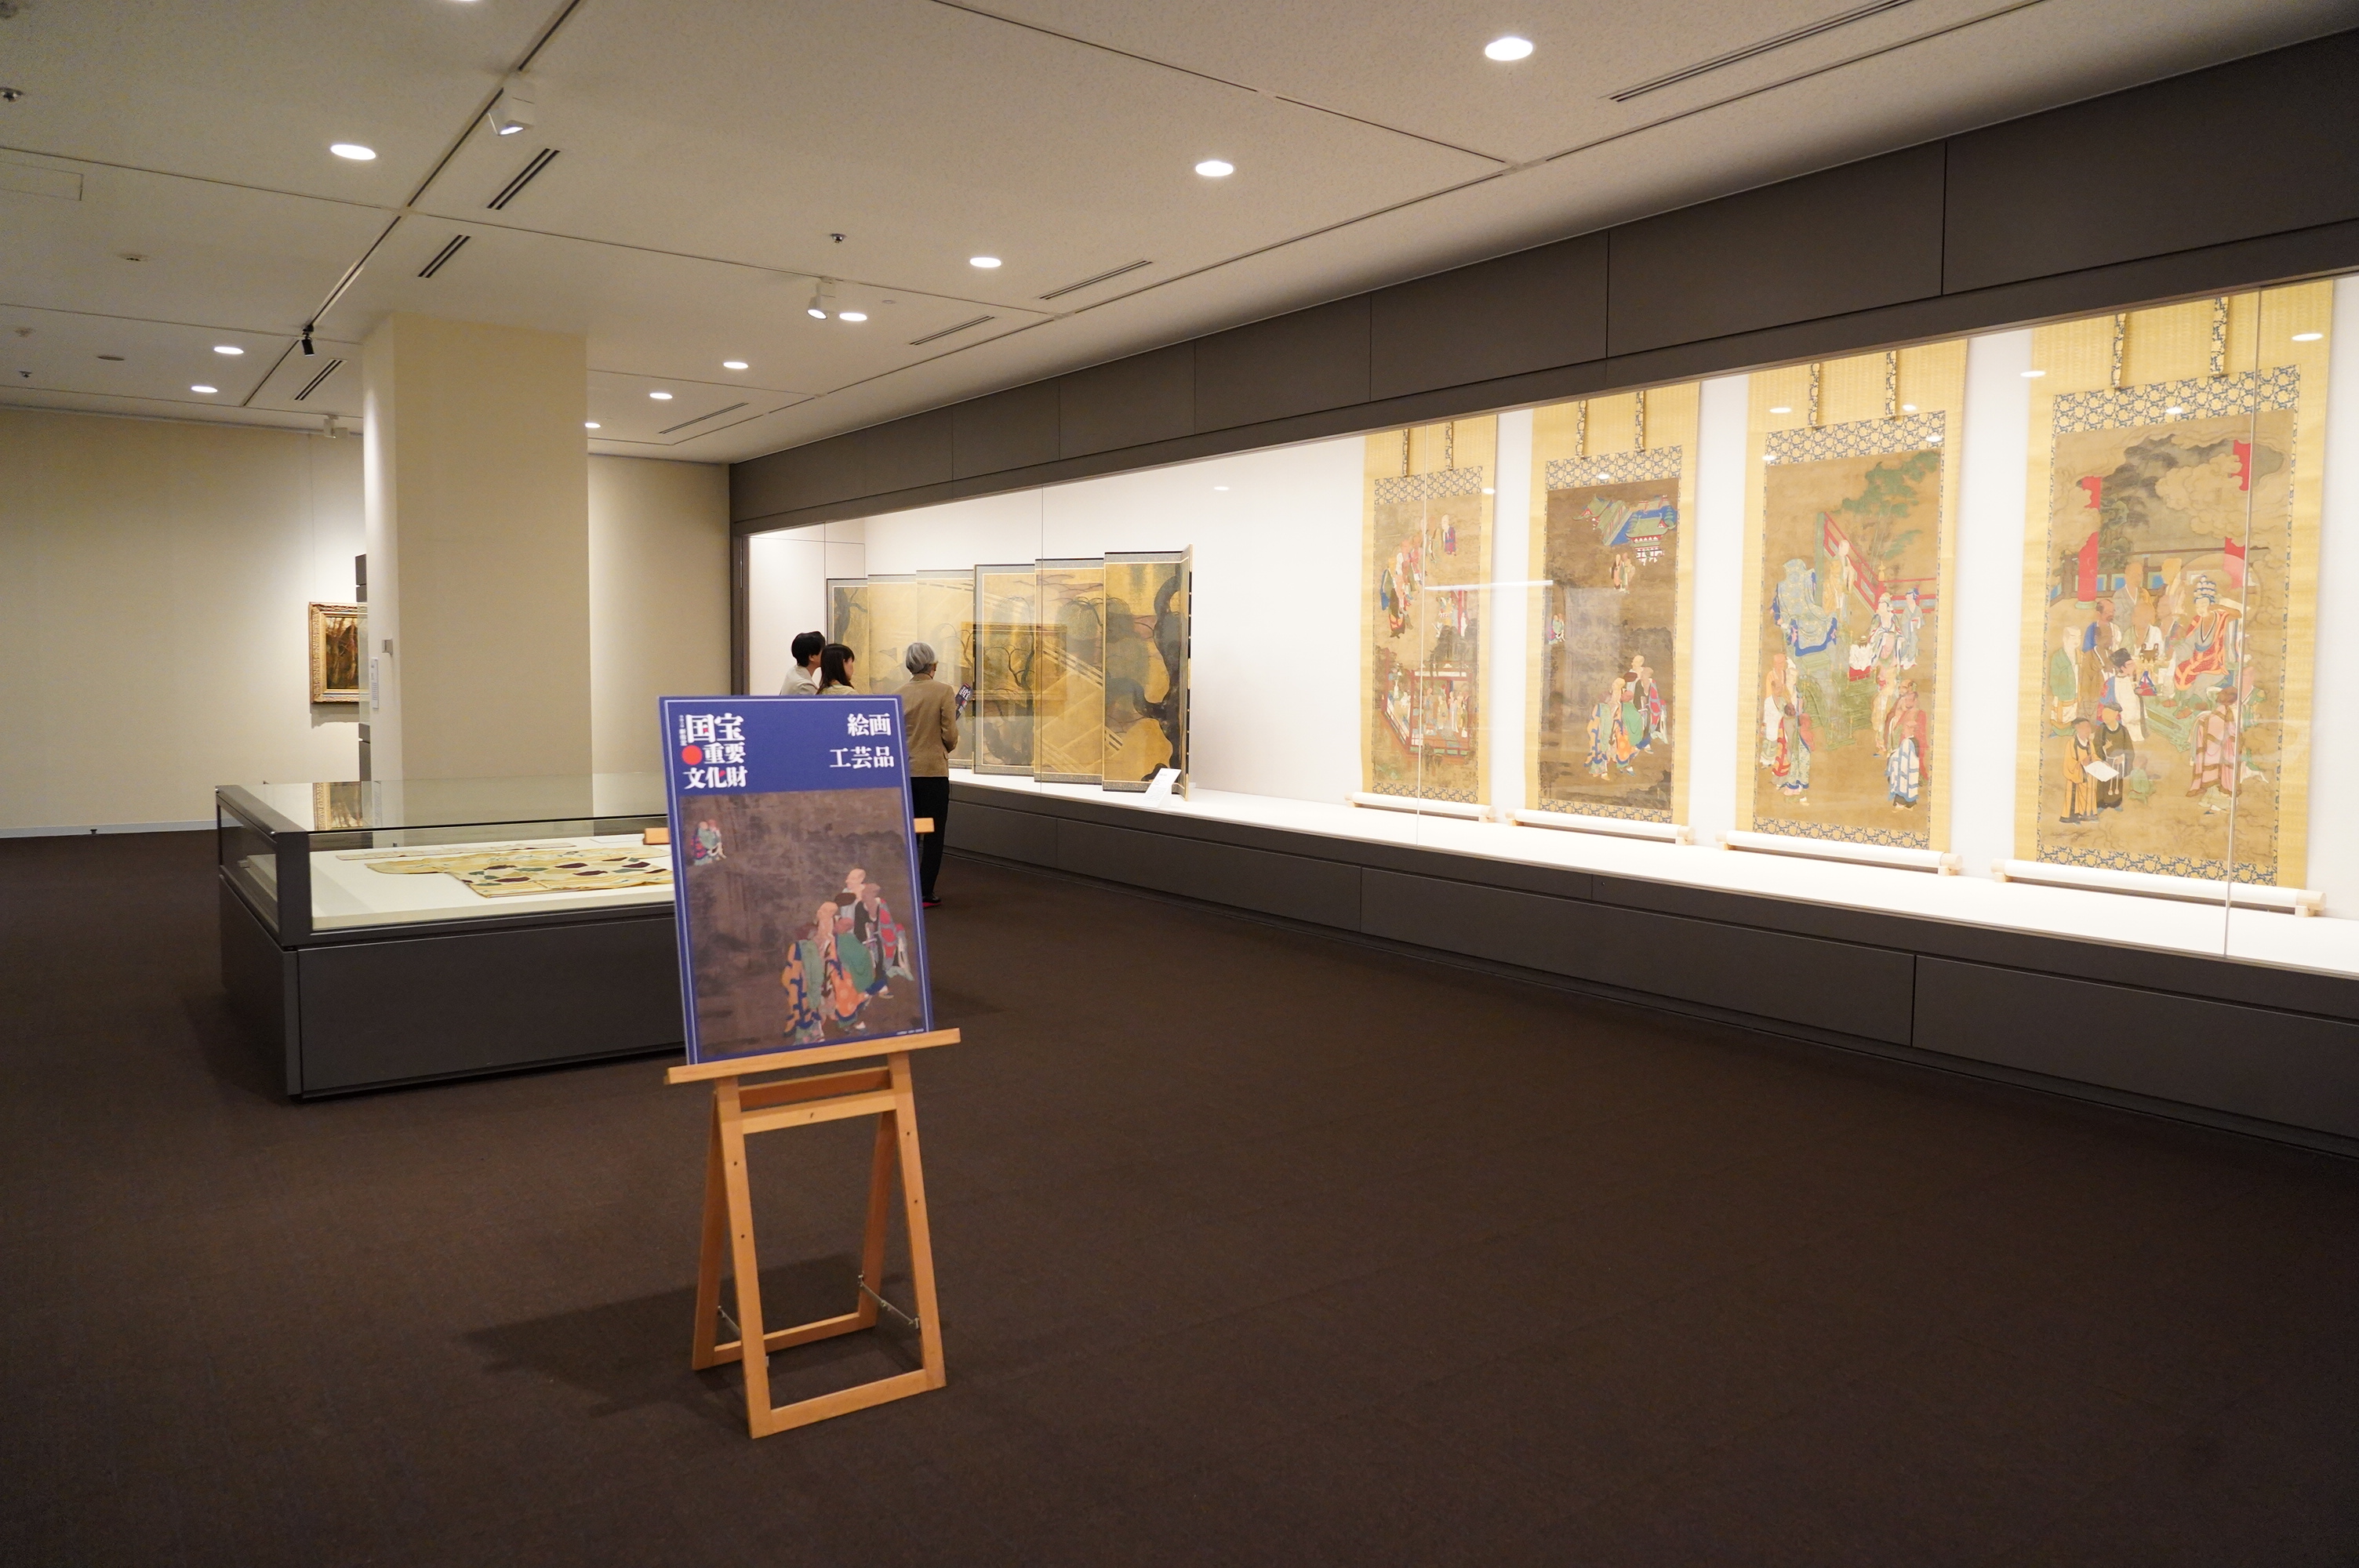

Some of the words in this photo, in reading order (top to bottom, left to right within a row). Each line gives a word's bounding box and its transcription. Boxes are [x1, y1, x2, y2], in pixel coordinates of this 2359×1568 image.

[685, 713, 746, 743] 国宝
[847, 713, 892, 737] 絵画
[703, 742, 747, 764] 重要
[830, 746, 895, 769] 工芸品
[683, 766, 748, 790] 文化財
